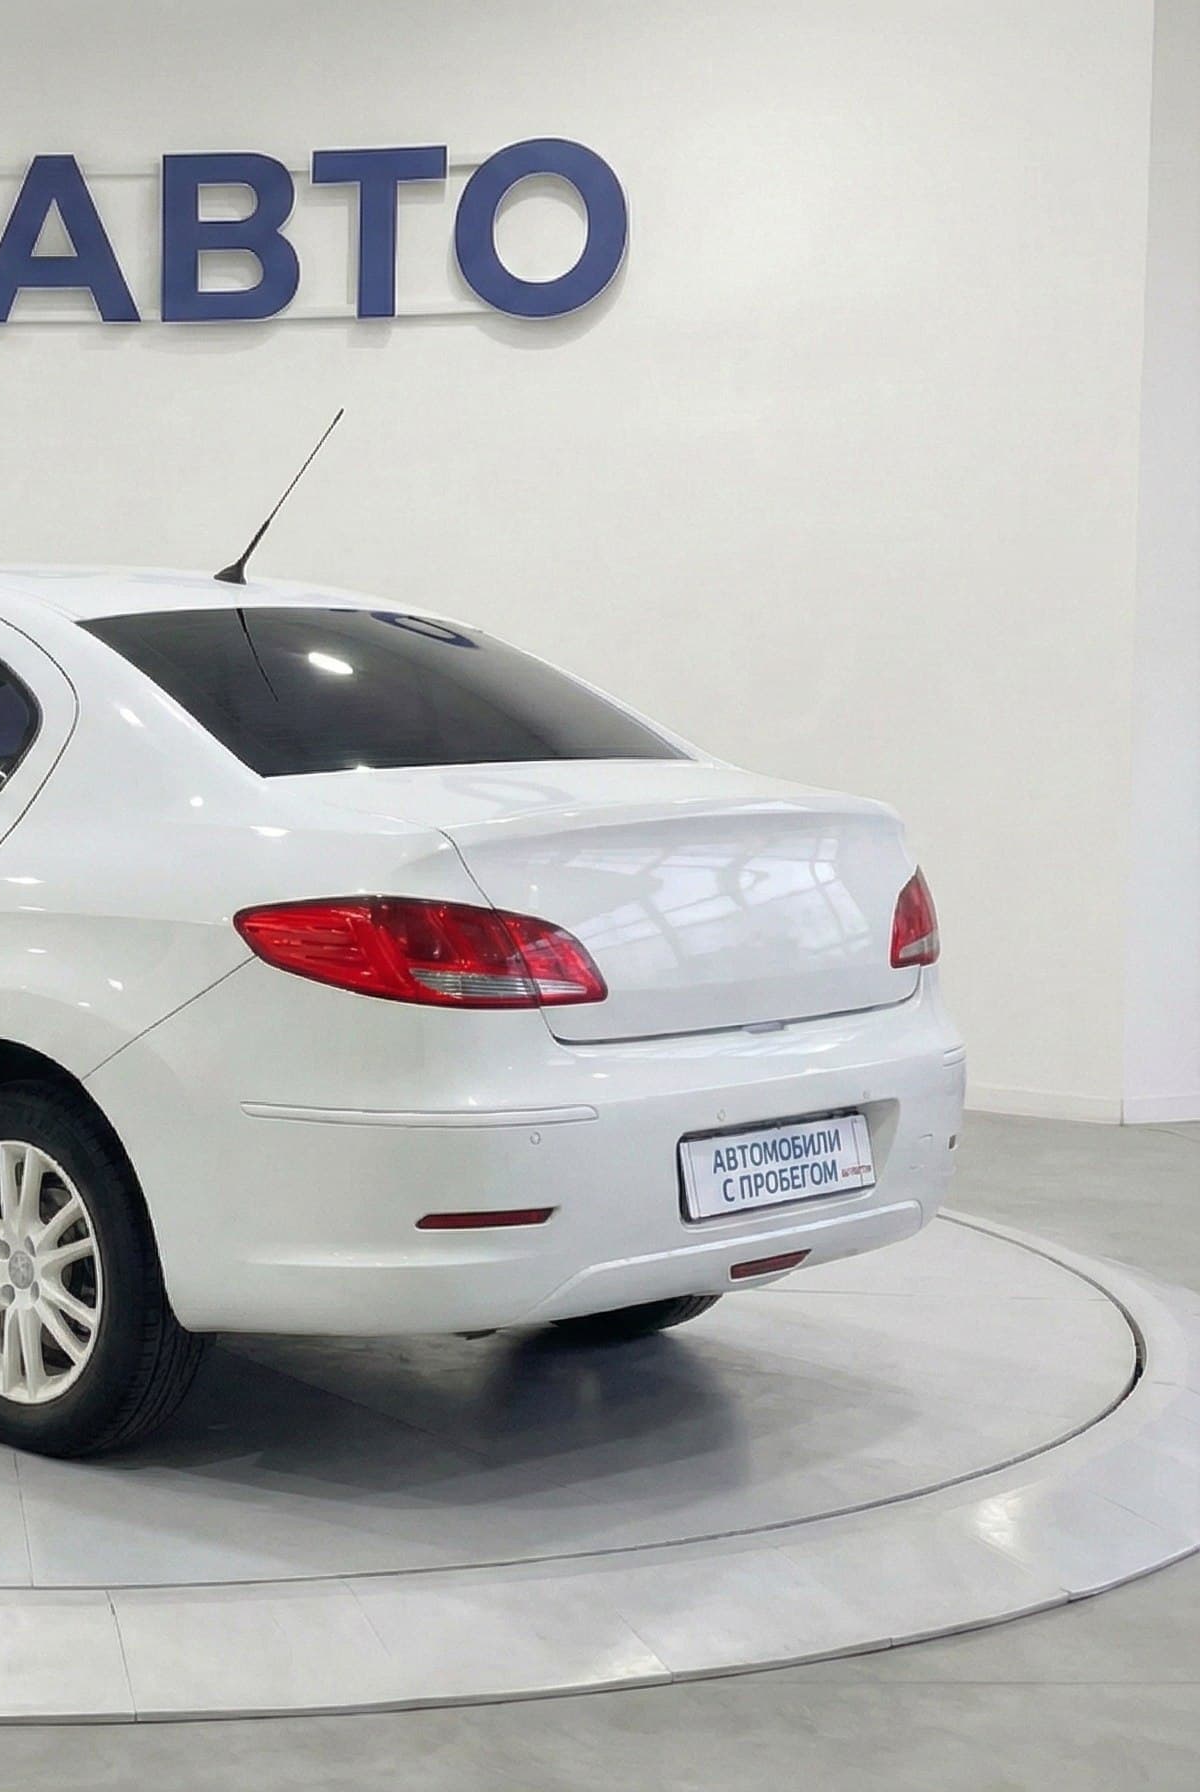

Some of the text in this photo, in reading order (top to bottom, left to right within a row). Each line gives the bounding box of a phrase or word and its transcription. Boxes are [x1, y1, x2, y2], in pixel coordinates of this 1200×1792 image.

[712, 1128, 842, 1174] АВТОМОБИЛИ
[722, 1178, 736, 1202] С
[739, 1159, 838, 1200] ПРОБЕГОМ
